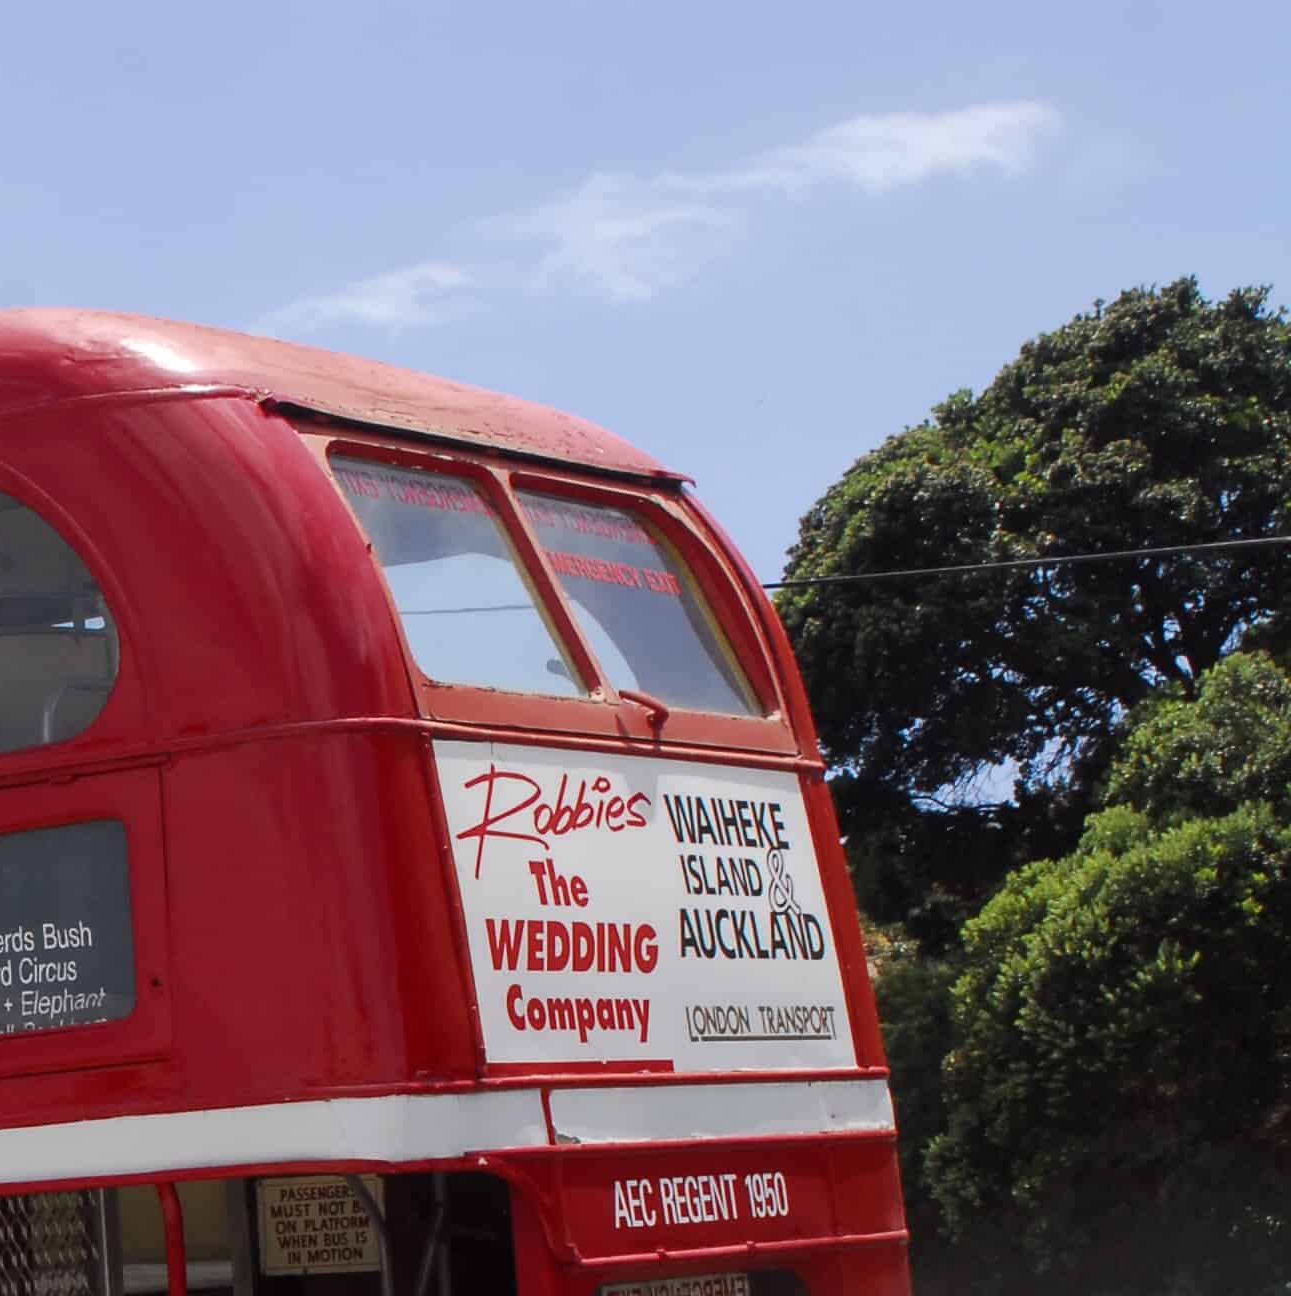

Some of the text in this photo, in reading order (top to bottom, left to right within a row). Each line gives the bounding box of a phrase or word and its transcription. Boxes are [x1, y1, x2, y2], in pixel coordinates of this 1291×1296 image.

[457, 763, 652, 880] Robbies
[664, 793, 789, 850] WAIHEKE
[528, 858, 588, 907] The
[680, 847, 801, 914] ISLAND &
[42, 920, 93, 950] Bush
[486, 918, 659, 973] WEDDING
[679, 908, 826, 960] AUCKLAND
[19, 957, 77, 984] Circus
[21, 987, 107, 1019] Elephant
[507, 984, 650, 1043] Company
[685, 1005, 837, 1042] LONDON TRANSPORT
[270, 1203, 311, 1218] MUST
[319, 1201, 345, 1216] NOT
[614, 1171, 789, 1229] AEC REGENT 1950
[275, 1215, 370, 1235] ON PLATFORM
[277, 1231, 368, 1249] WHEN BUS IS
[287, 1247, 364, 1265] IN MOTION
